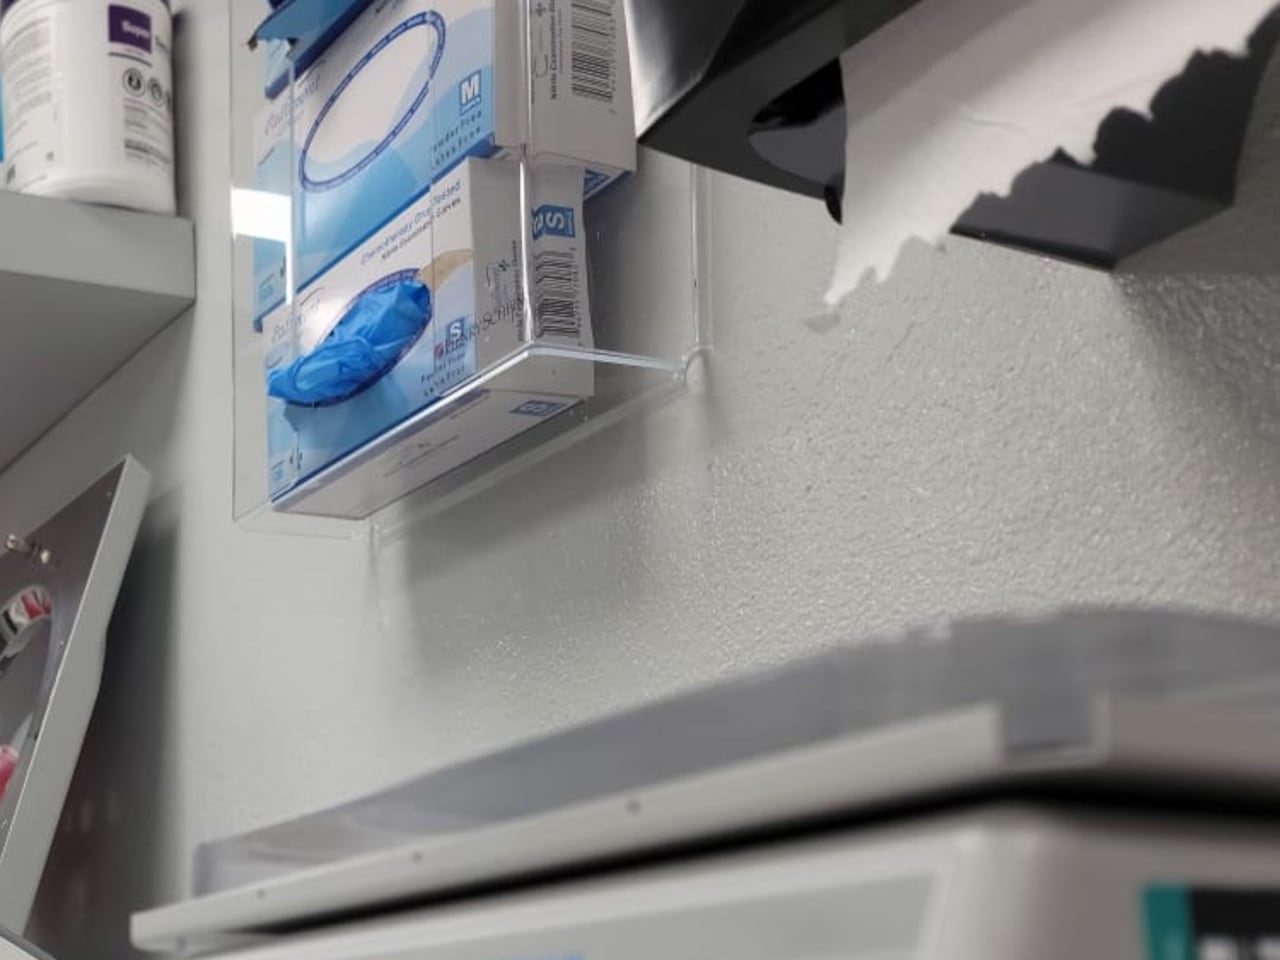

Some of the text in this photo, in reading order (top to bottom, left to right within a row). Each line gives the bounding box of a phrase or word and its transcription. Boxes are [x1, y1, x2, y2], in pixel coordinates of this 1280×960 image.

[461, 73, 480, 105] M
[545, 210, 564, 230] S
[449, 321, 463, 337] S
